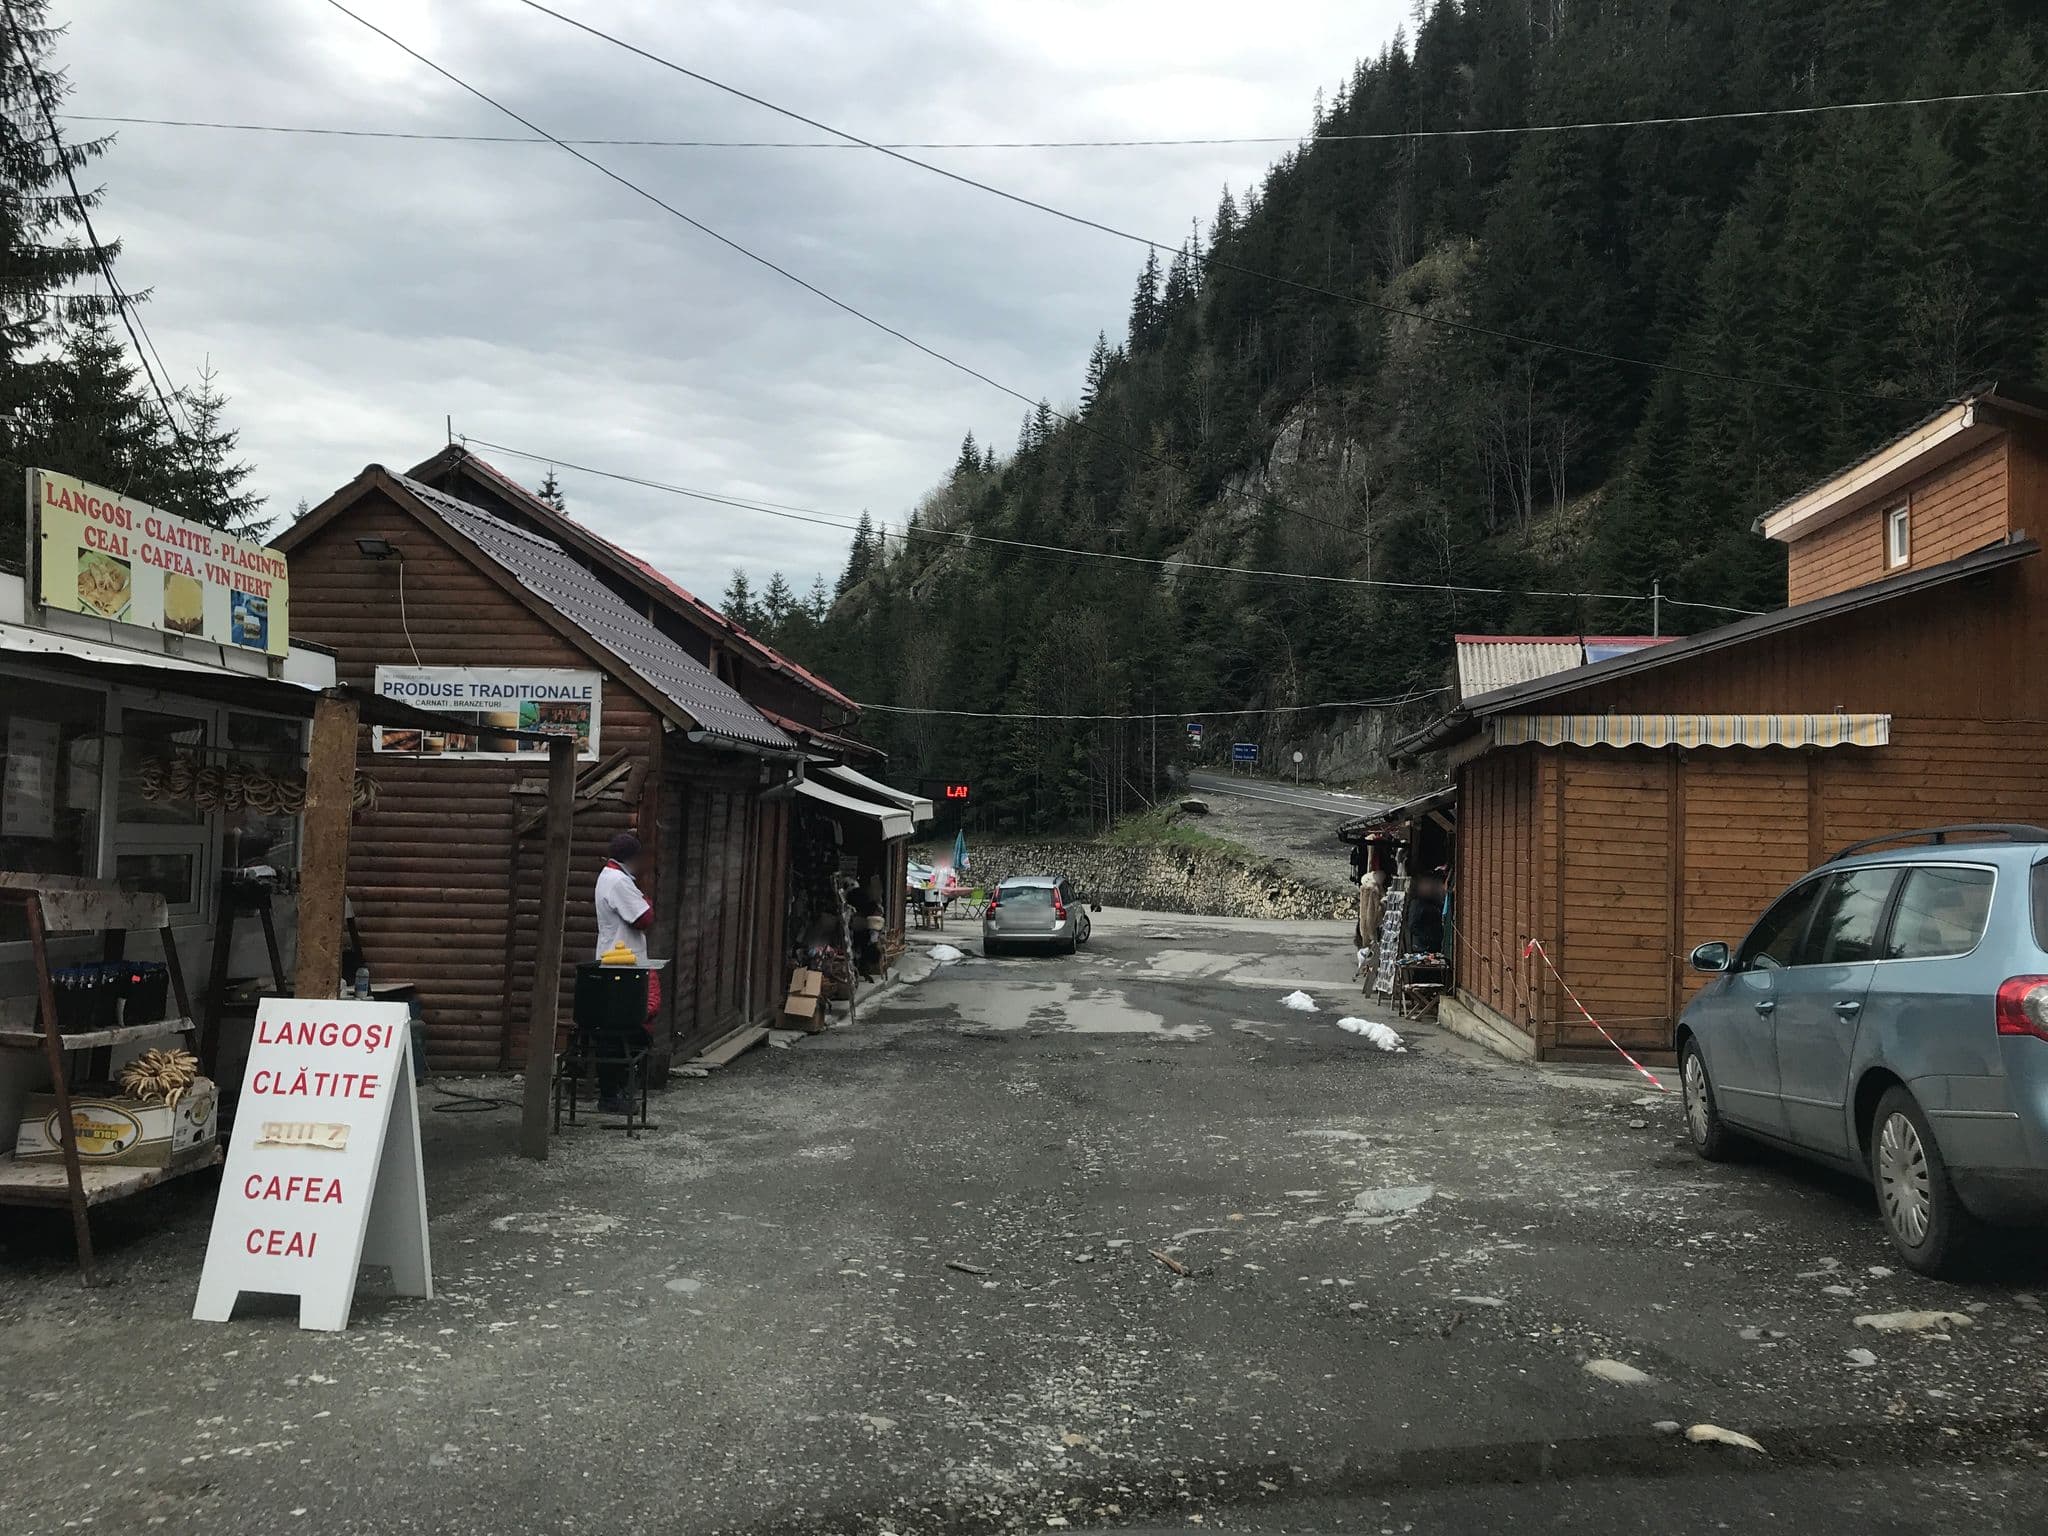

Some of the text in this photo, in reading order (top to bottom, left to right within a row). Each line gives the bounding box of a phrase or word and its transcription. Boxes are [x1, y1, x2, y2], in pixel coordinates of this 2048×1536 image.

[46, 481, 286, 580] LANGOSI CLATITE PLACINTE
[84, 525, 272, 599] CEAI CAFEA VIN FIERT
[383, 682, 592, 699] PRODUSE TRADITIONALE
[415, 699, 448, 707] CARNATI
[453, 700, 502, 708] BRANZETURI
[252, 1066, 379, 1099] CLĂTITE
[244, 1174, 343, 1204] CAFEA
[246, 1228, 317, 1258] CEAI
